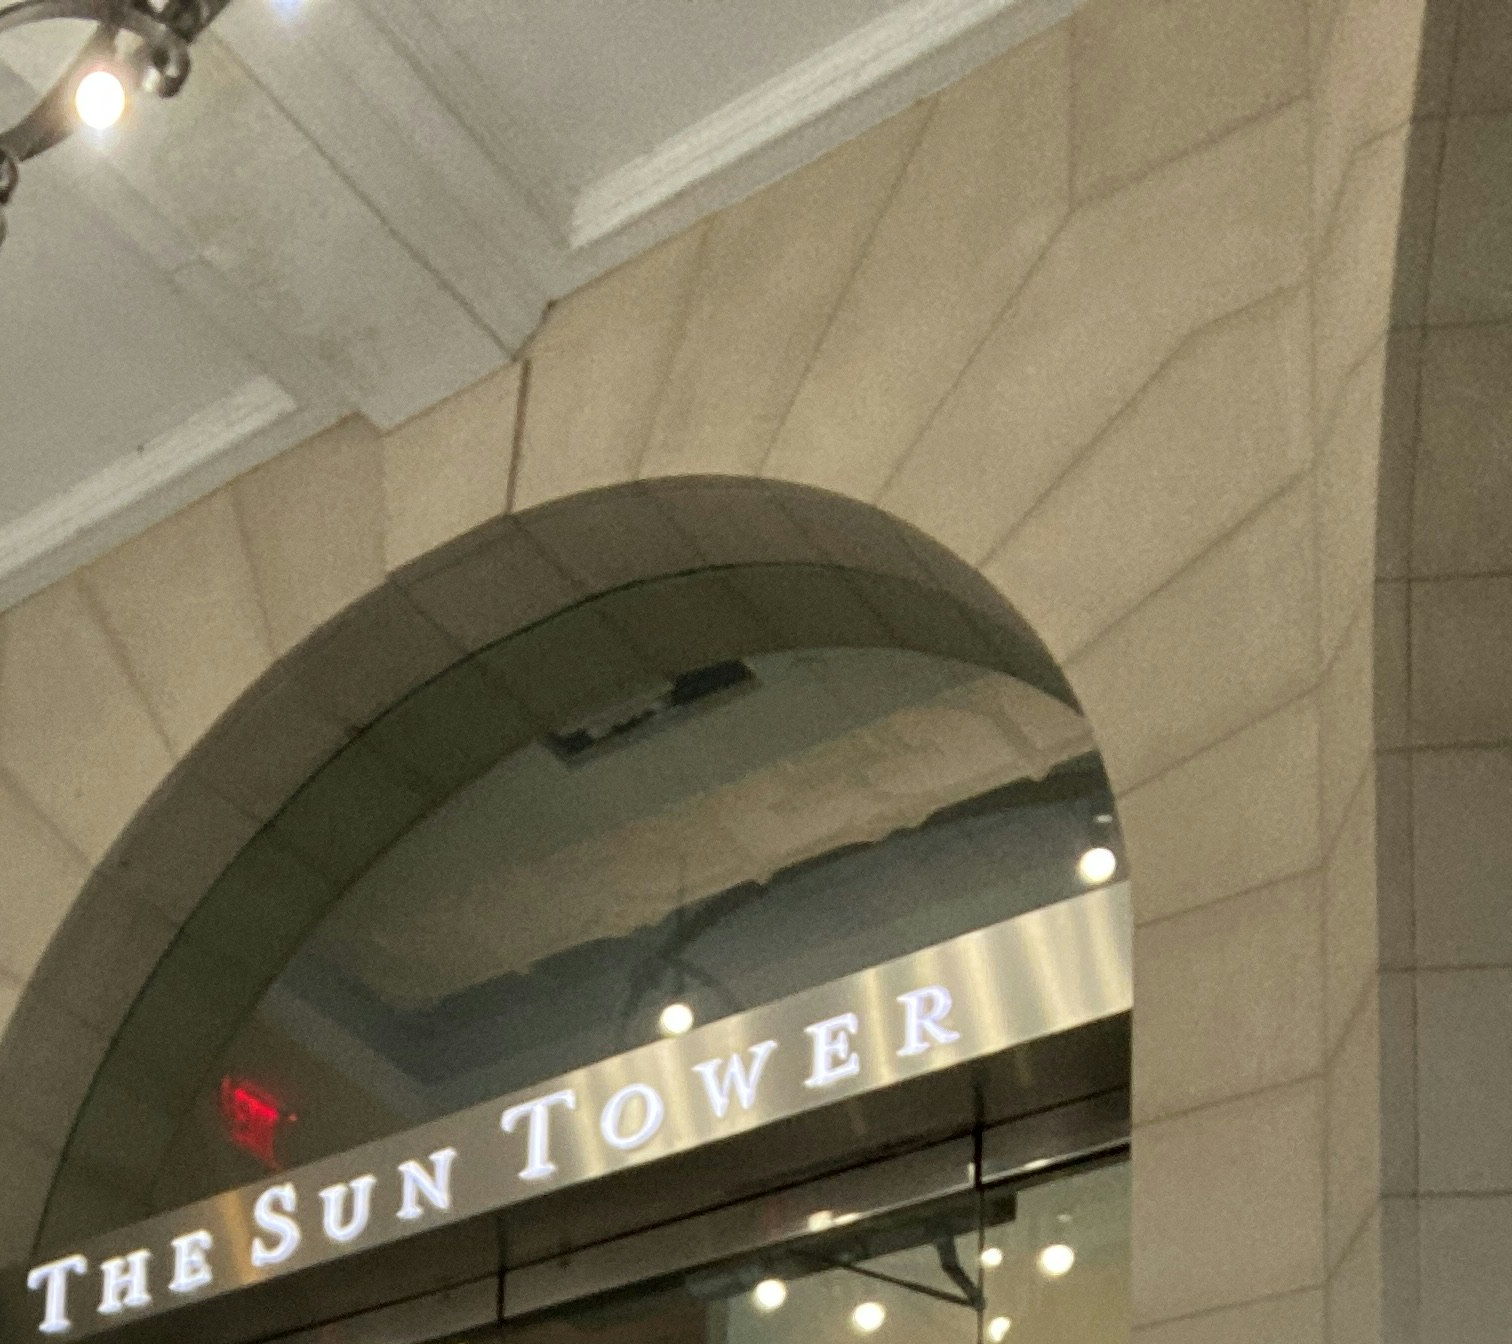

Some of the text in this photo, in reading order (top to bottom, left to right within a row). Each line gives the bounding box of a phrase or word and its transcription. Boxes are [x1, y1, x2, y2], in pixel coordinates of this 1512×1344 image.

[26, 985, 960, 1334] THE SUN TOWER
